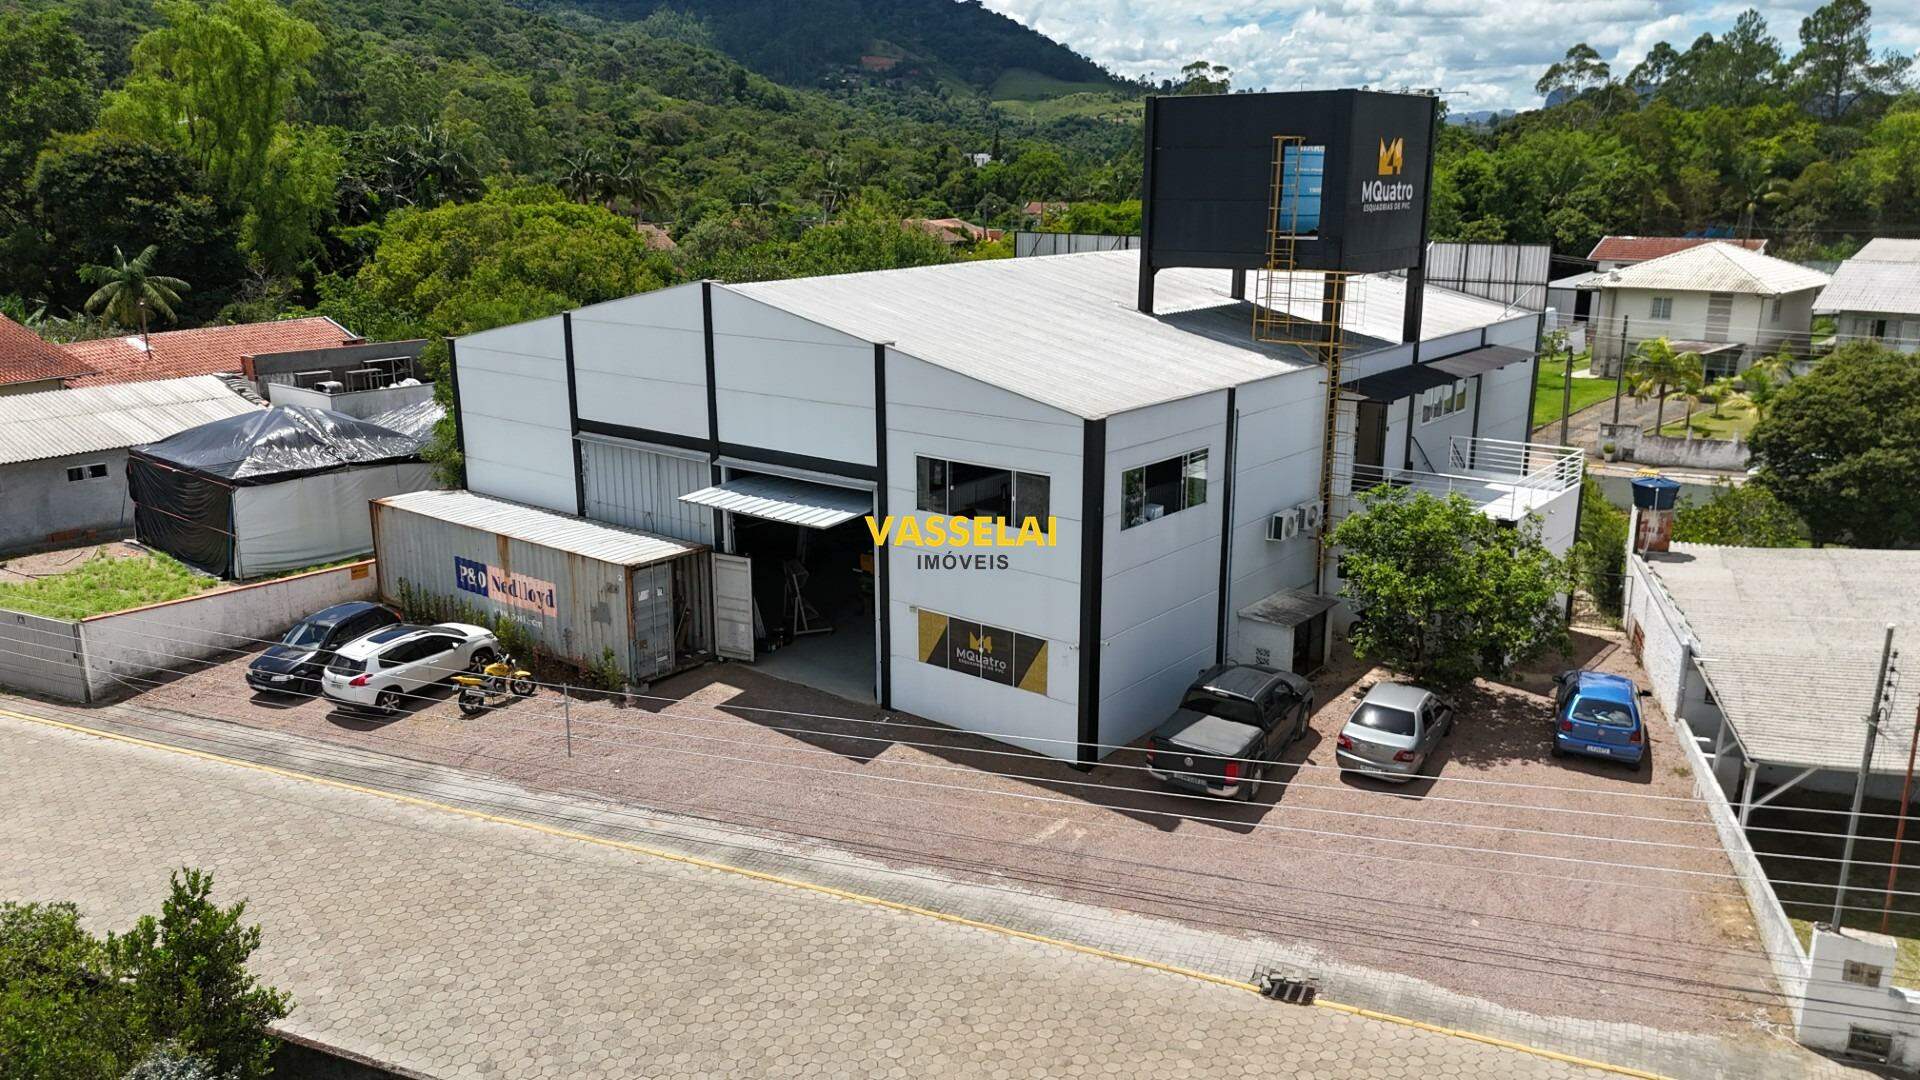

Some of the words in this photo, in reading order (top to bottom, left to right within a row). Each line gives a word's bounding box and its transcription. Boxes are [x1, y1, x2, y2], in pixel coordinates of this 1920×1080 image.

[1361, 180, 1414, 203] MQuatro
[459, 564, 487, 588] P&O
[491, 574, 555, 610] Nedlloyd
[956, 647, 1007, 670] MQuatro
